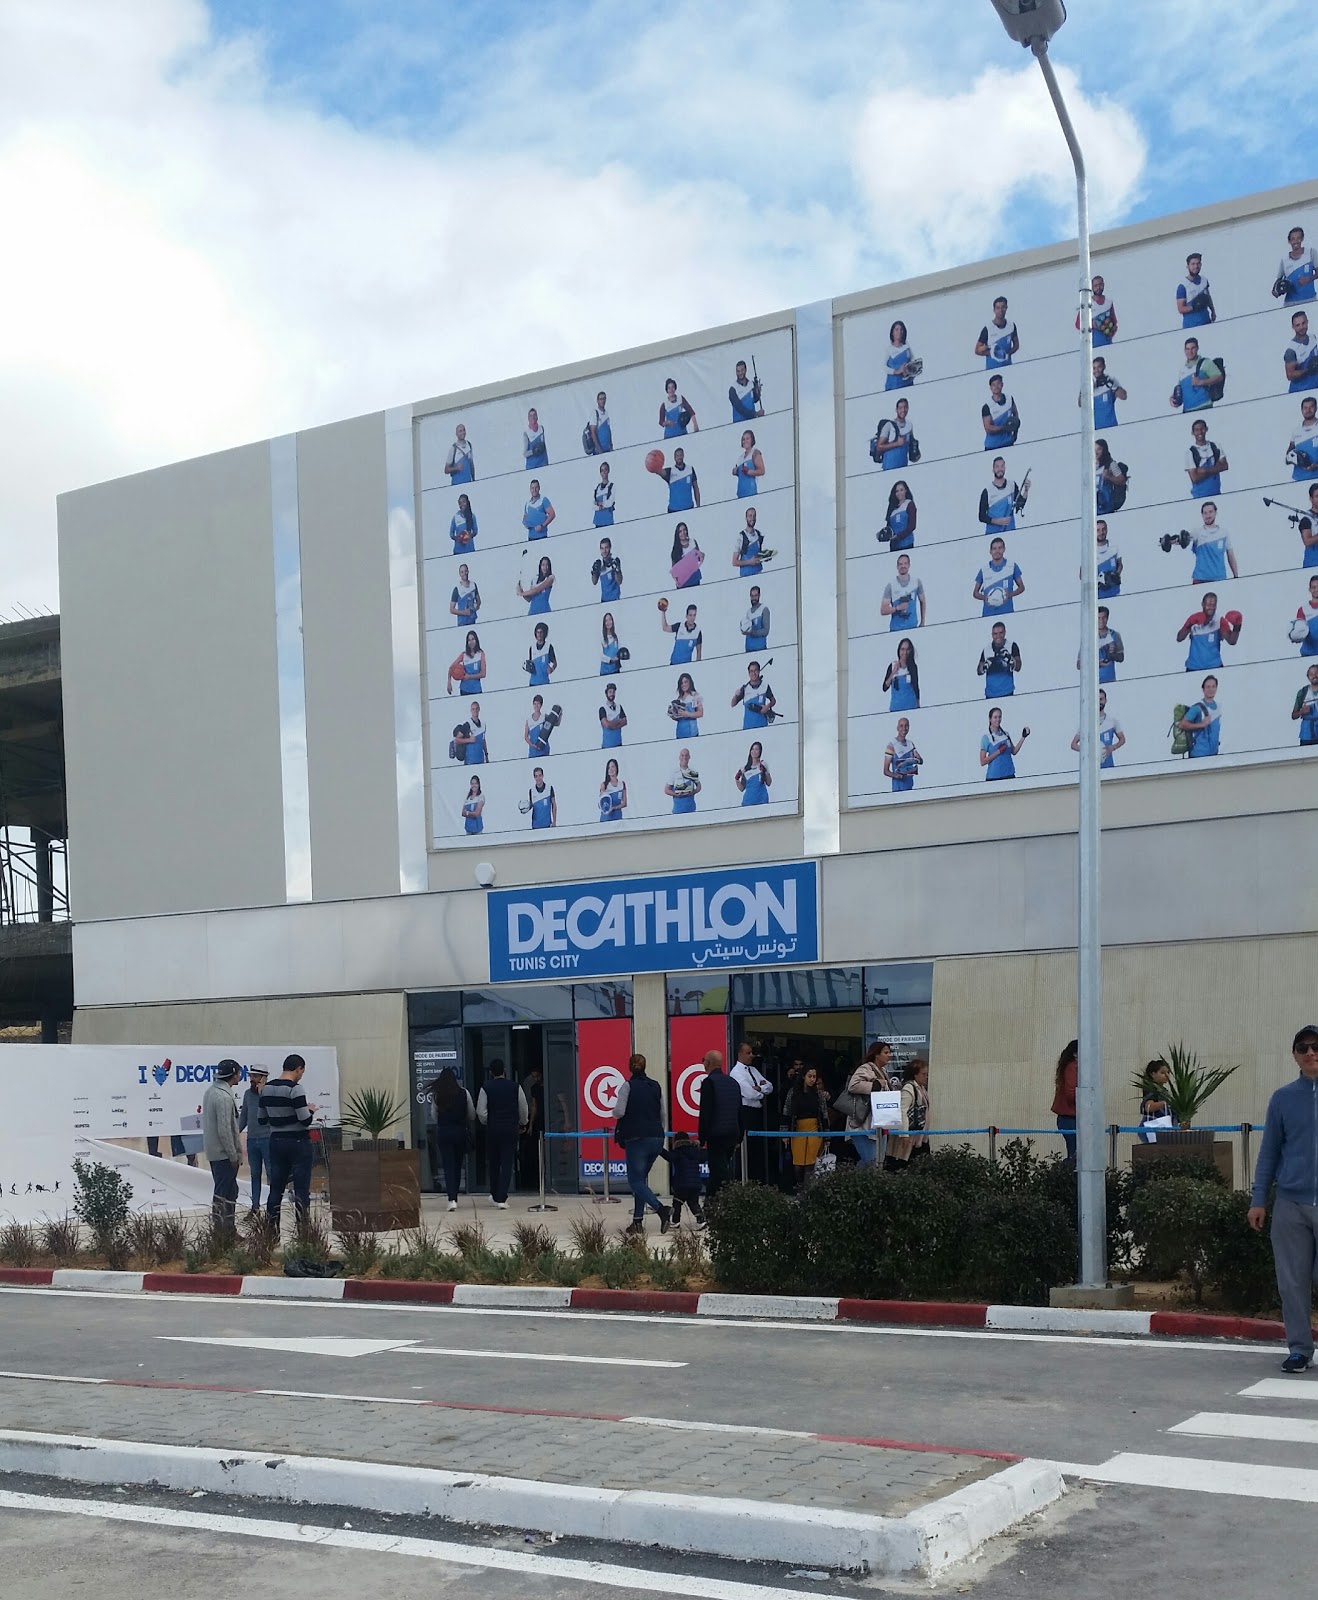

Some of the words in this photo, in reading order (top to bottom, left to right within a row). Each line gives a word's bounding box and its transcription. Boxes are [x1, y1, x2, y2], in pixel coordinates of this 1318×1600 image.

[507, 878, 798, 955] DECATHLON
[691, 943, 744, 968] سيتي
[744, 937, 798, 961] تونس
[508, 956, 547, 972] TUNIS
[549, 954, 580, 970] CITY
[138, 1065, 147, 1084] I
